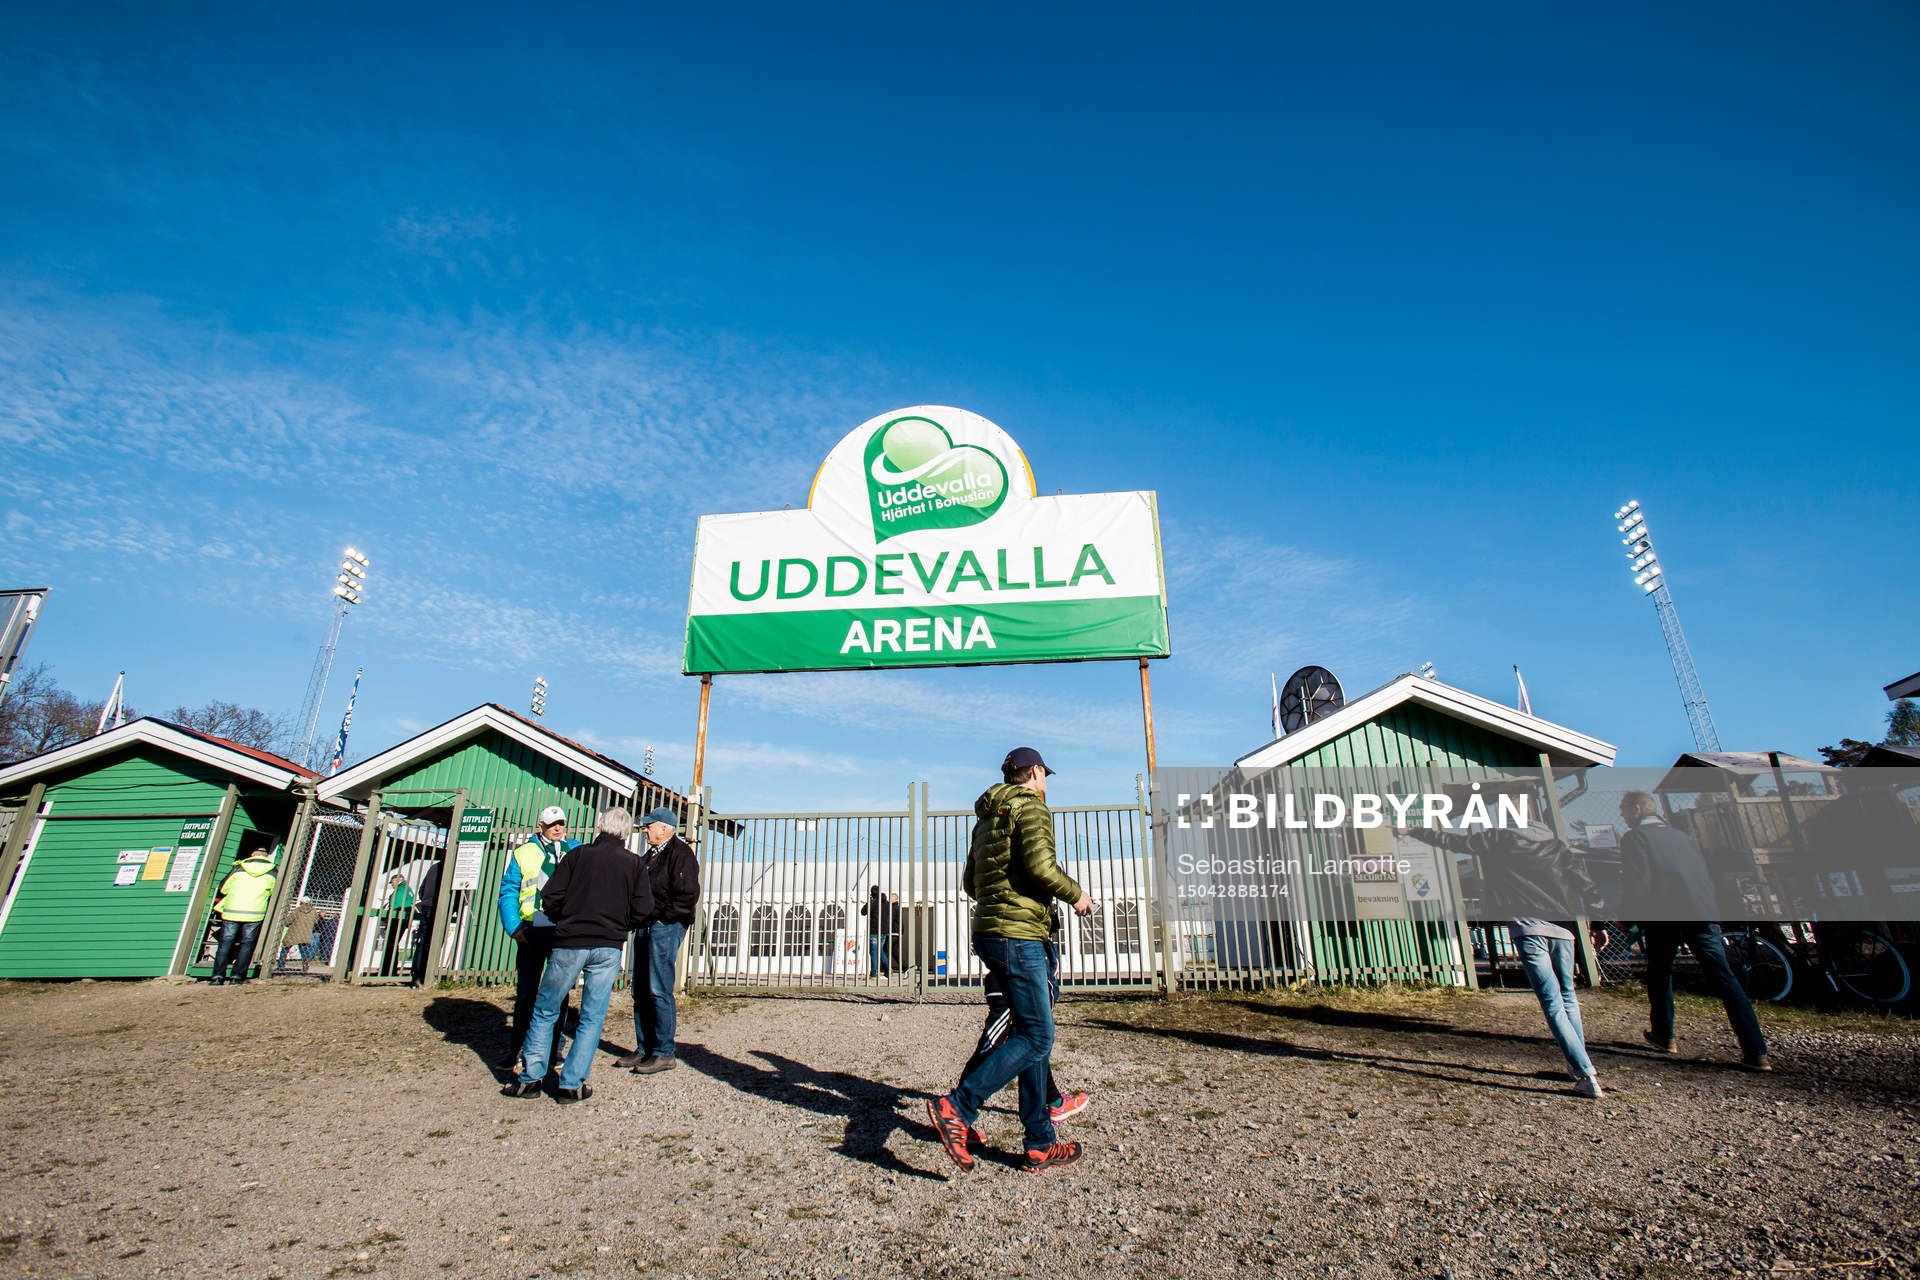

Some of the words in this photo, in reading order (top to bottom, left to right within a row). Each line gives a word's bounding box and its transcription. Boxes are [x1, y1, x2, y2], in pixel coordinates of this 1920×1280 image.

[877, 471, 992, 509] Uddevalla
[881, 503, 926, 522] Hjärtat
[929, 500, 933, 511] i
[935, 487, 995, 510] Bohuslän
[729, 543, 1116, 602] UDDEVALLA
[839, 616, 997, 654] ARENA
[460, 824, 488, 833] STÅPLATS
[462, 815, 492, 824] SITTPLATS
[1355, 873, 1396, 881] SECURITAS
[1357, 895, 1399, 903] bevakning
